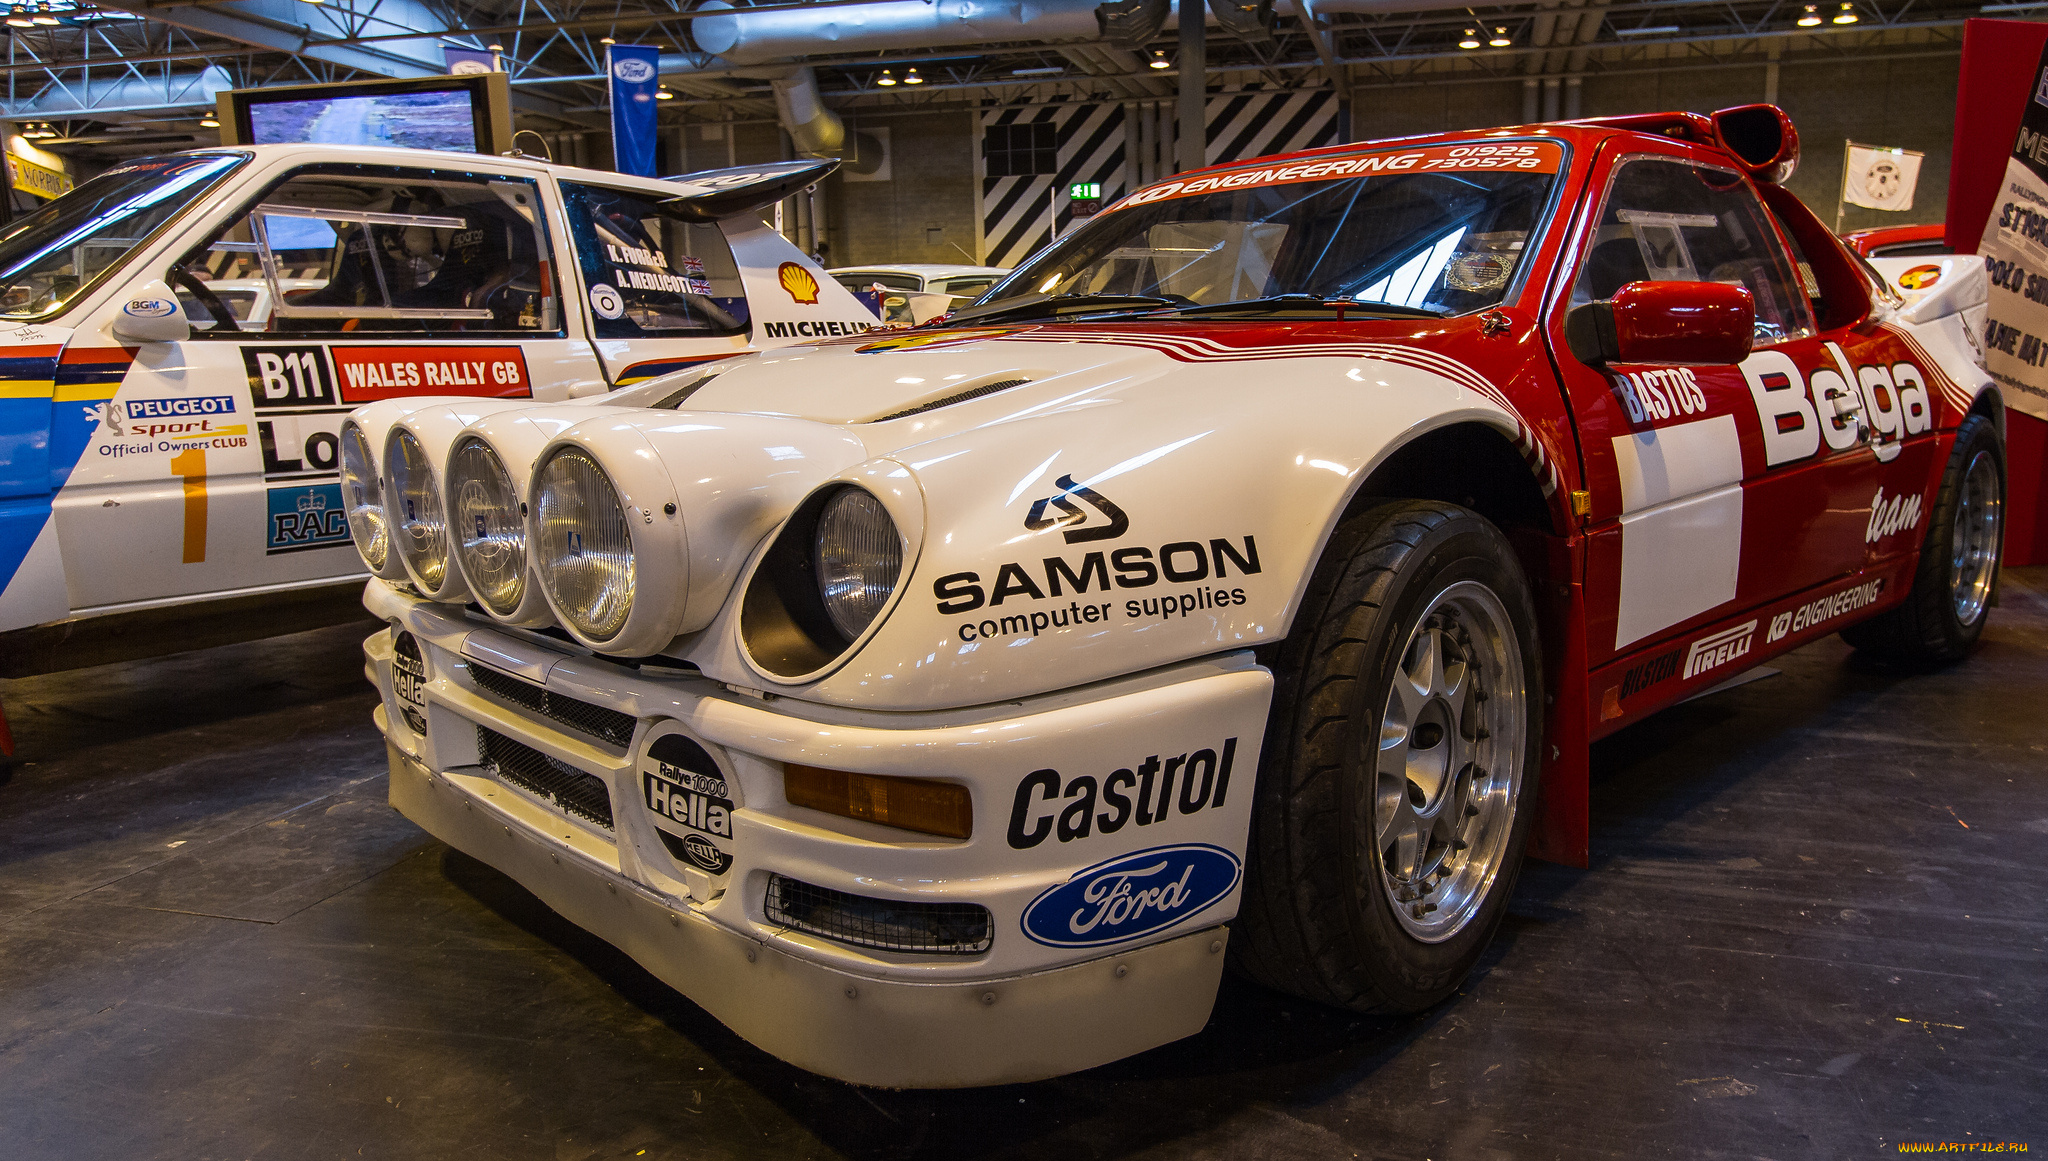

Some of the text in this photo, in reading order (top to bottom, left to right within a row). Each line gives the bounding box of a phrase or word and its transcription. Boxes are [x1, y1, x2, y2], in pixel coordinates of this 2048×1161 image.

[1421, 157, 1541, 170] 730578
[1448, 146, 1539, 158] 01925
[1113, 154, 1425, 210] KD ENGINEERING
[454, 229, 484, 245] sparco
[607, 244, 622, 263] K.
[616, 269, 693, 294] A. MEDLICOTT
[132, 301, 159, 309] BGM
[256, 352, 323, 399] B11
[344, 361, 520, 388] WALES RALLY GB
[129, 397, 231, 417] PEUGEOT
[1619, 366, 1707, 423] BASTOS
[1737, 341, 1932, 467] Belga
[99, 437, 248, 458] Official Owners CLUB
[131, 420, 213, 438] sport
[170, 448, 208, 563] 1
[1865, 486, 1922, 543] team
[273, 509, 346, 545] RAC
[933, 534, 1263, 615] SAMSON
[958, 586, 1247, 642] computer supplies
[1620, 578, 1881, 700] BILSTEIN PIRELLI KD ENGINEERING
[394, 666, 425, 705] Hella
[659, 762, 729, 798] Rallye 1000
[1006, 737, 1238, 850] Castrol
[650, 776, 730, 836] Hella
[686, 842, 721, 864] HELLA
[1069, 860, 1195, 935] Ford
